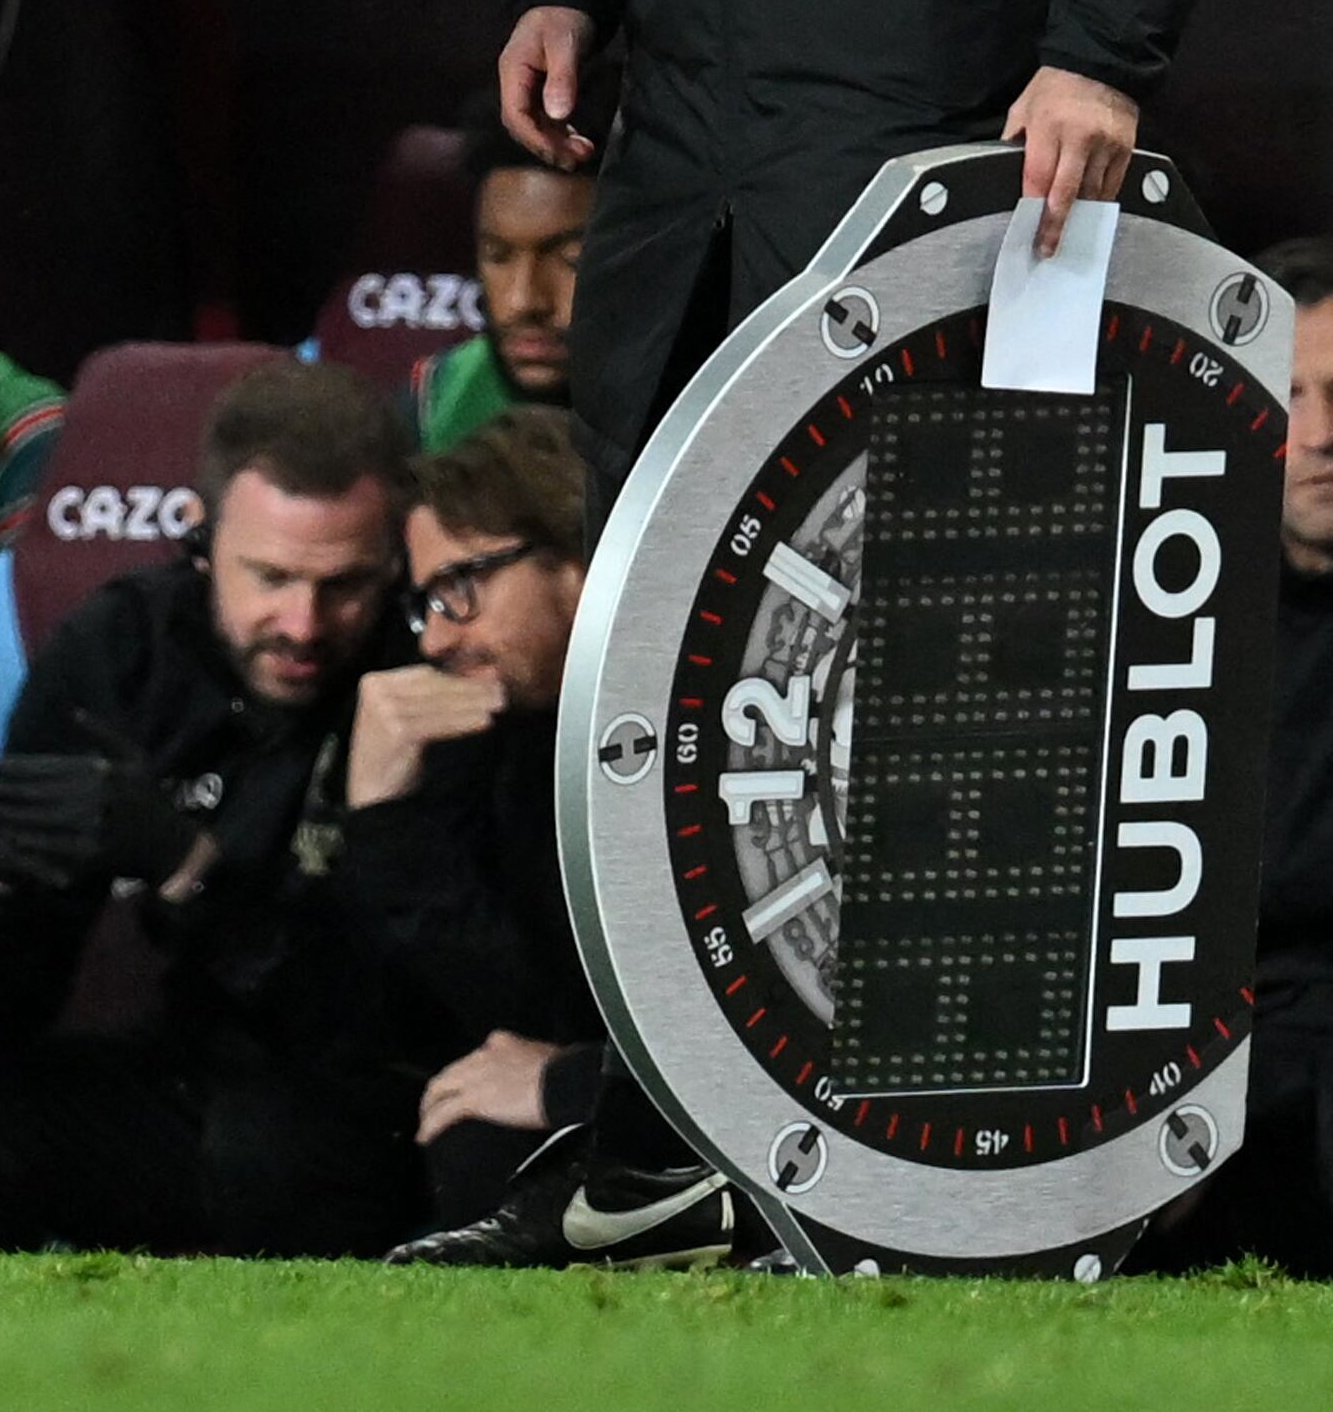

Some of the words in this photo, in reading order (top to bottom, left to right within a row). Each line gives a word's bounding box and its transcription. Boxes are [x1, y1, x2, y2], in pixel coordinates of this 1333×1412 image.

[1189, 351, 1225, 388] 20
[729, 513, 763, 557] 05
[676, 722, 700, 765] 60
[1105, 421, 1227, 1032] HUBLOT
[718, 674, 812, 826] 12
[702, 925, 734, 969] 55
[1148, 1061, 1182, 1096] 40
[974, 1128, 1010, 1156] 45
